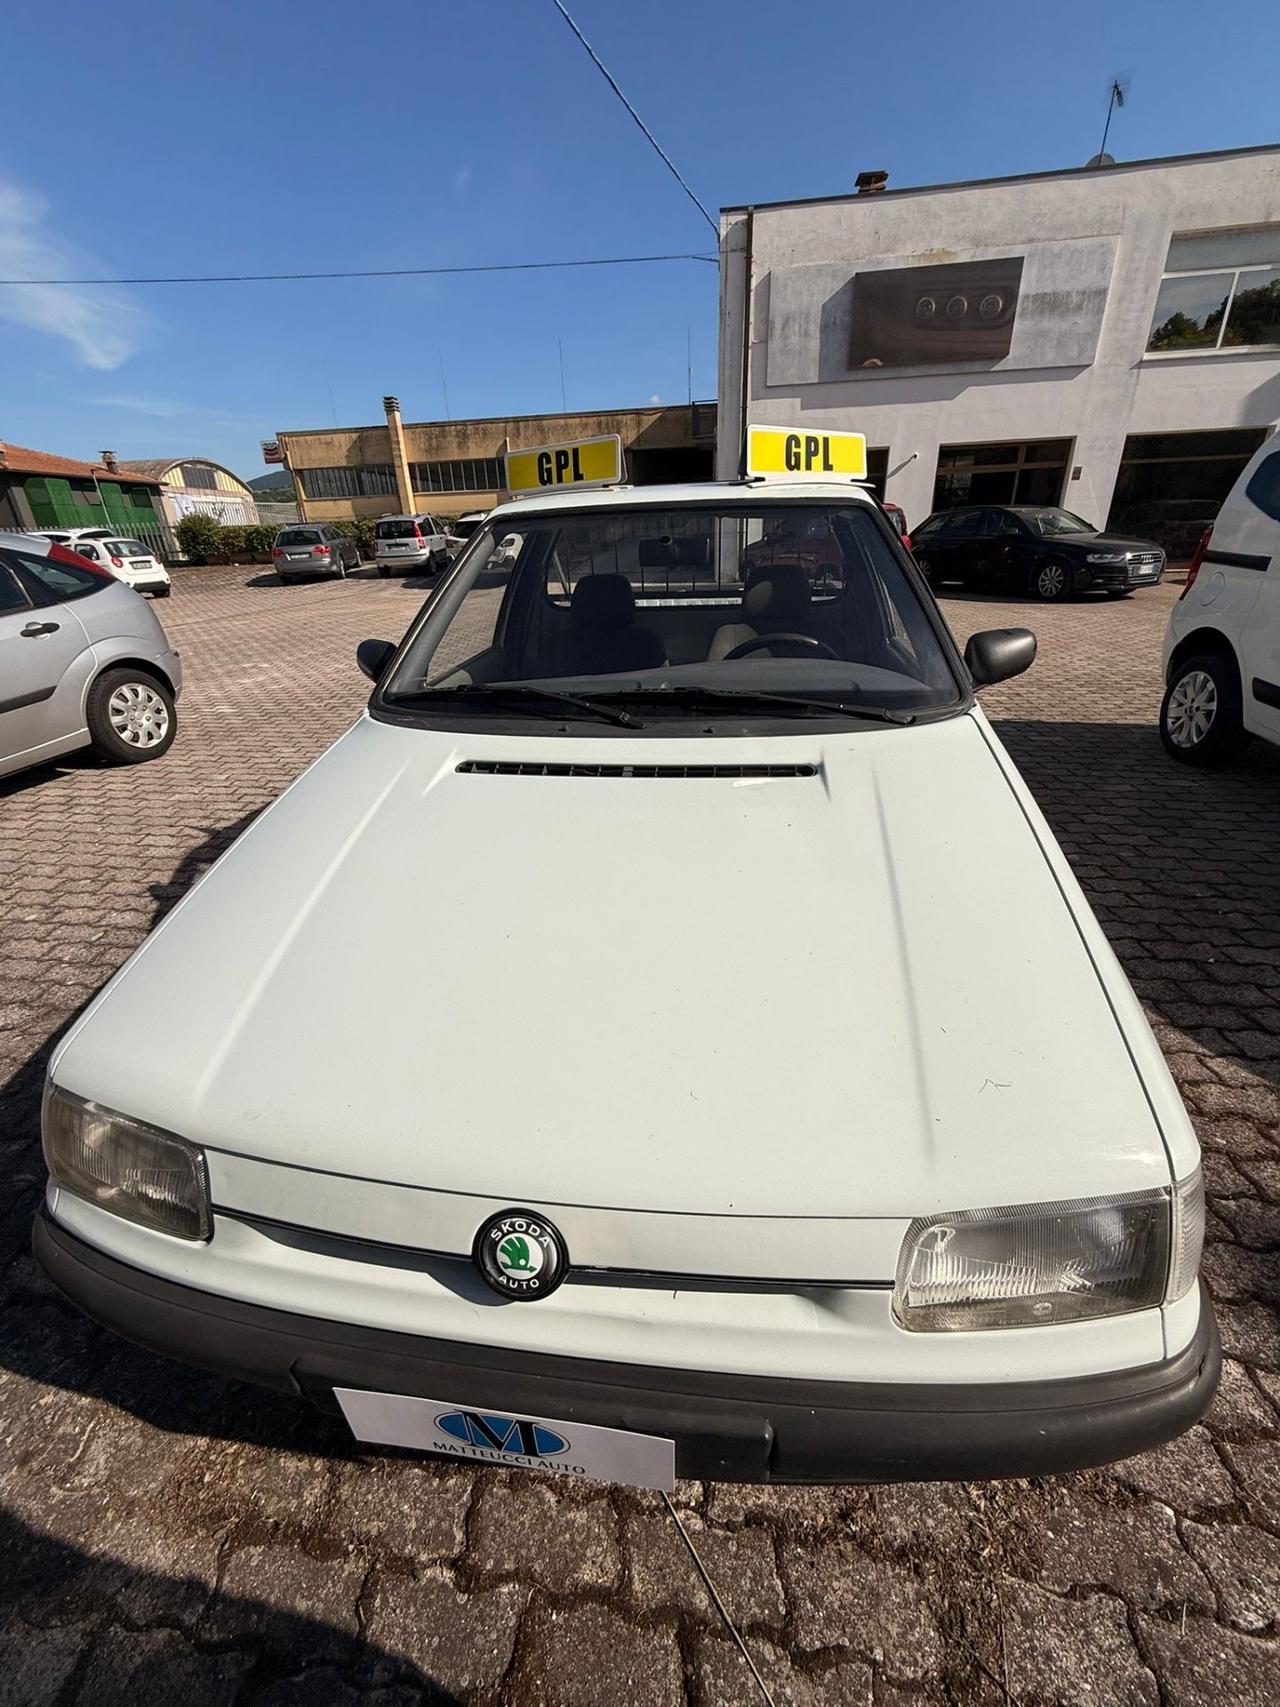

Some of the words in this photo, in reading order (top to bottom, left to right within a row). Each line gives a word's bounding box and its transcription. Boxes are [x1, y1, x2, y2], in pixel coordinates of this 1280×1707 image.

[537, 447, 584, 486] GPL
[785, 434, 834, 472] GPL
[498, 1275, 540, 1290] AUTO
[433, 1441, 532, 1466] MATTEUCCI
[537, 1460, 586, 1475] AUTO
